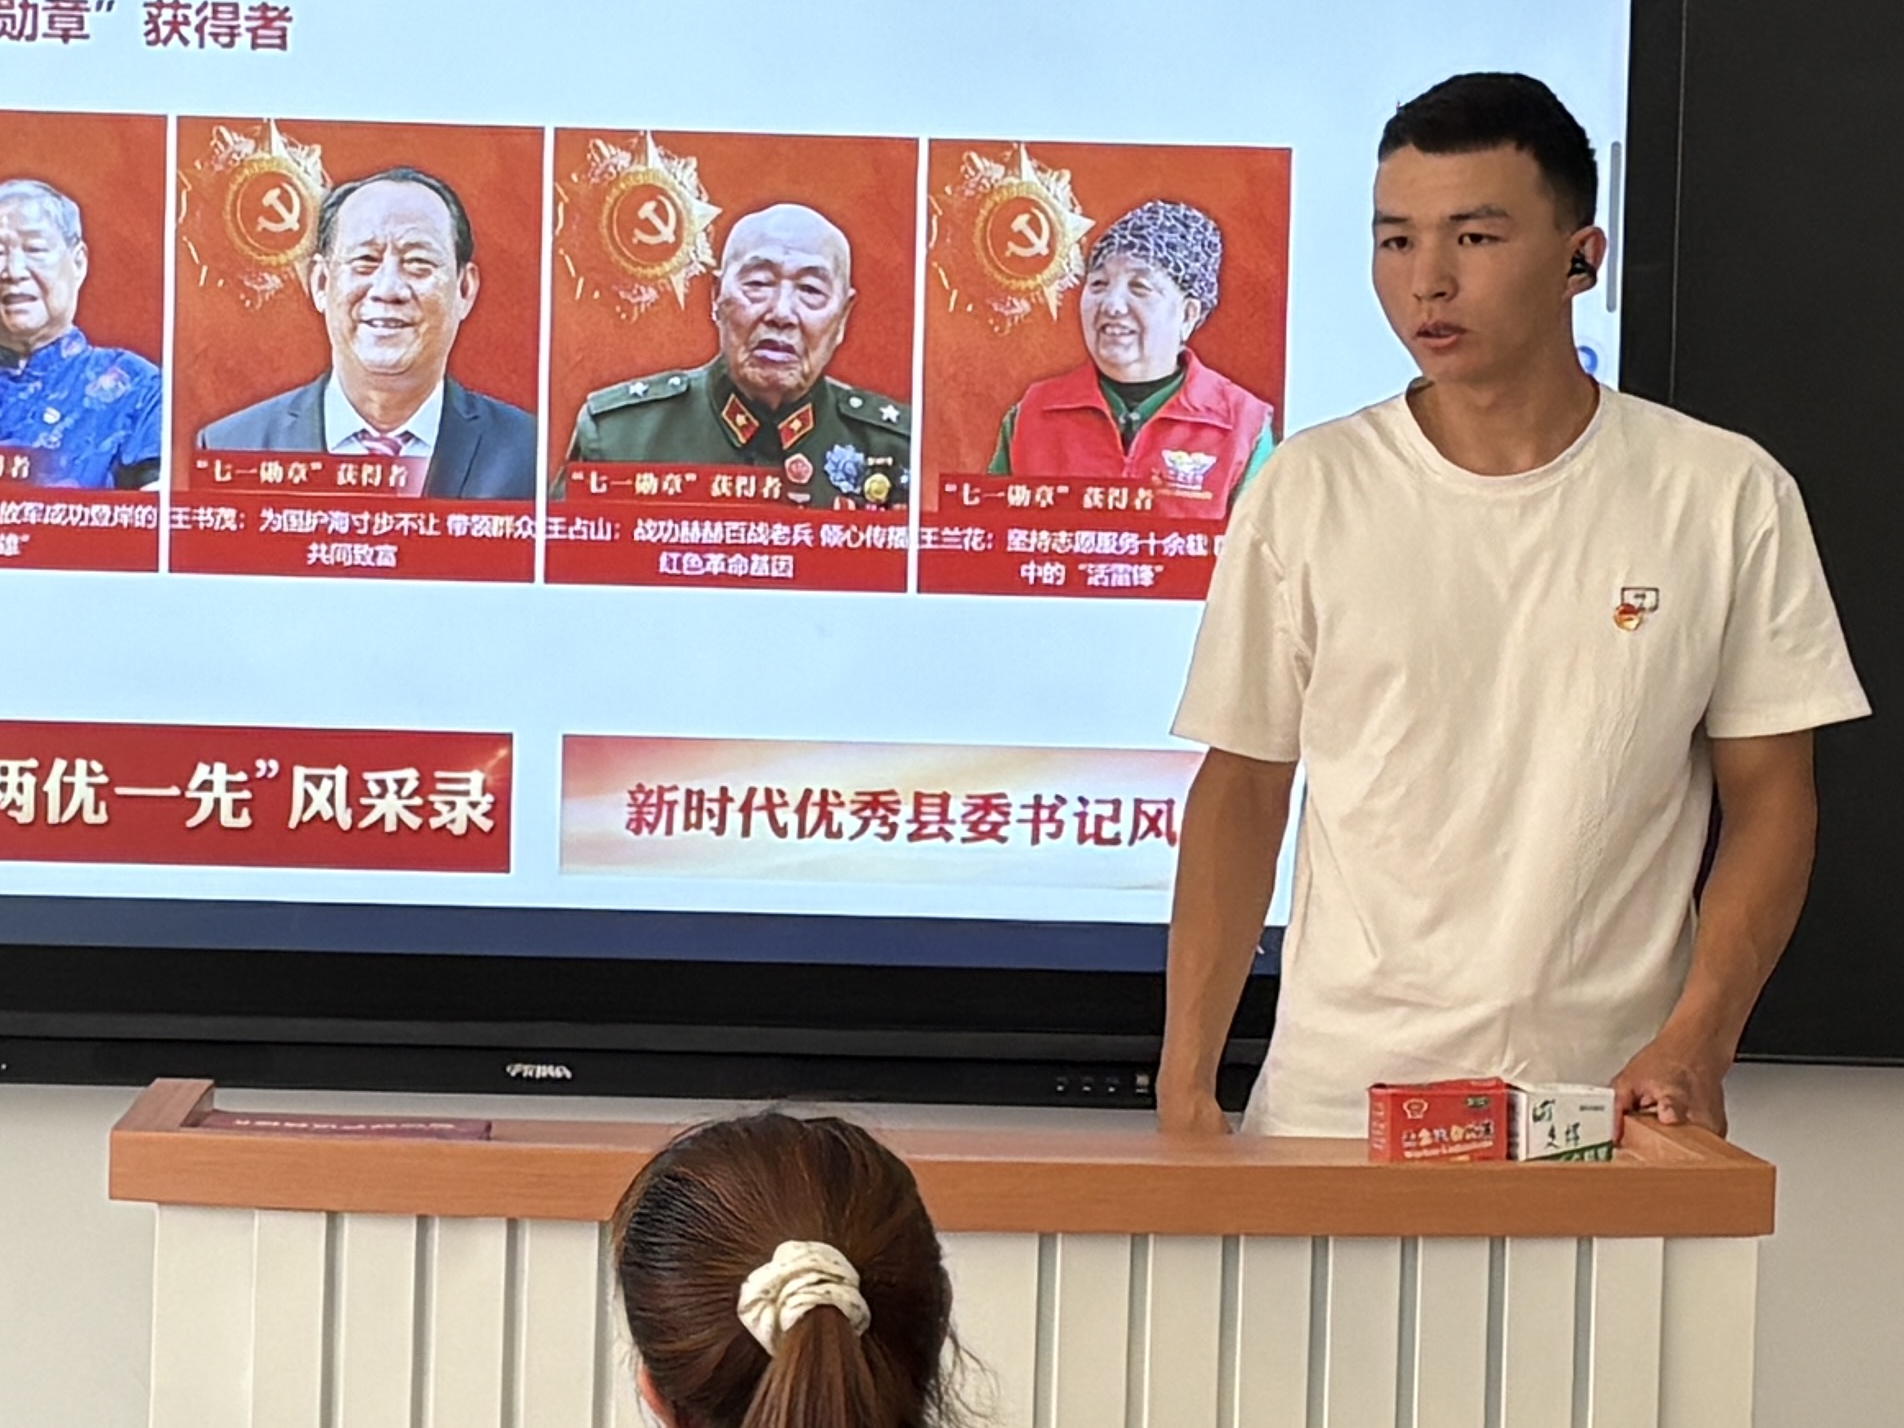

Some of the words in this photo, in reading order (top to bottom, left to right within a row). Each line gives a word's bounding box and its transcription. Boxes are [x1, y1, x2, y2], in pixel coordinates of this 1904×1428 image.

[625, 782, 1178, 848] 新时代优秀县委书记风
